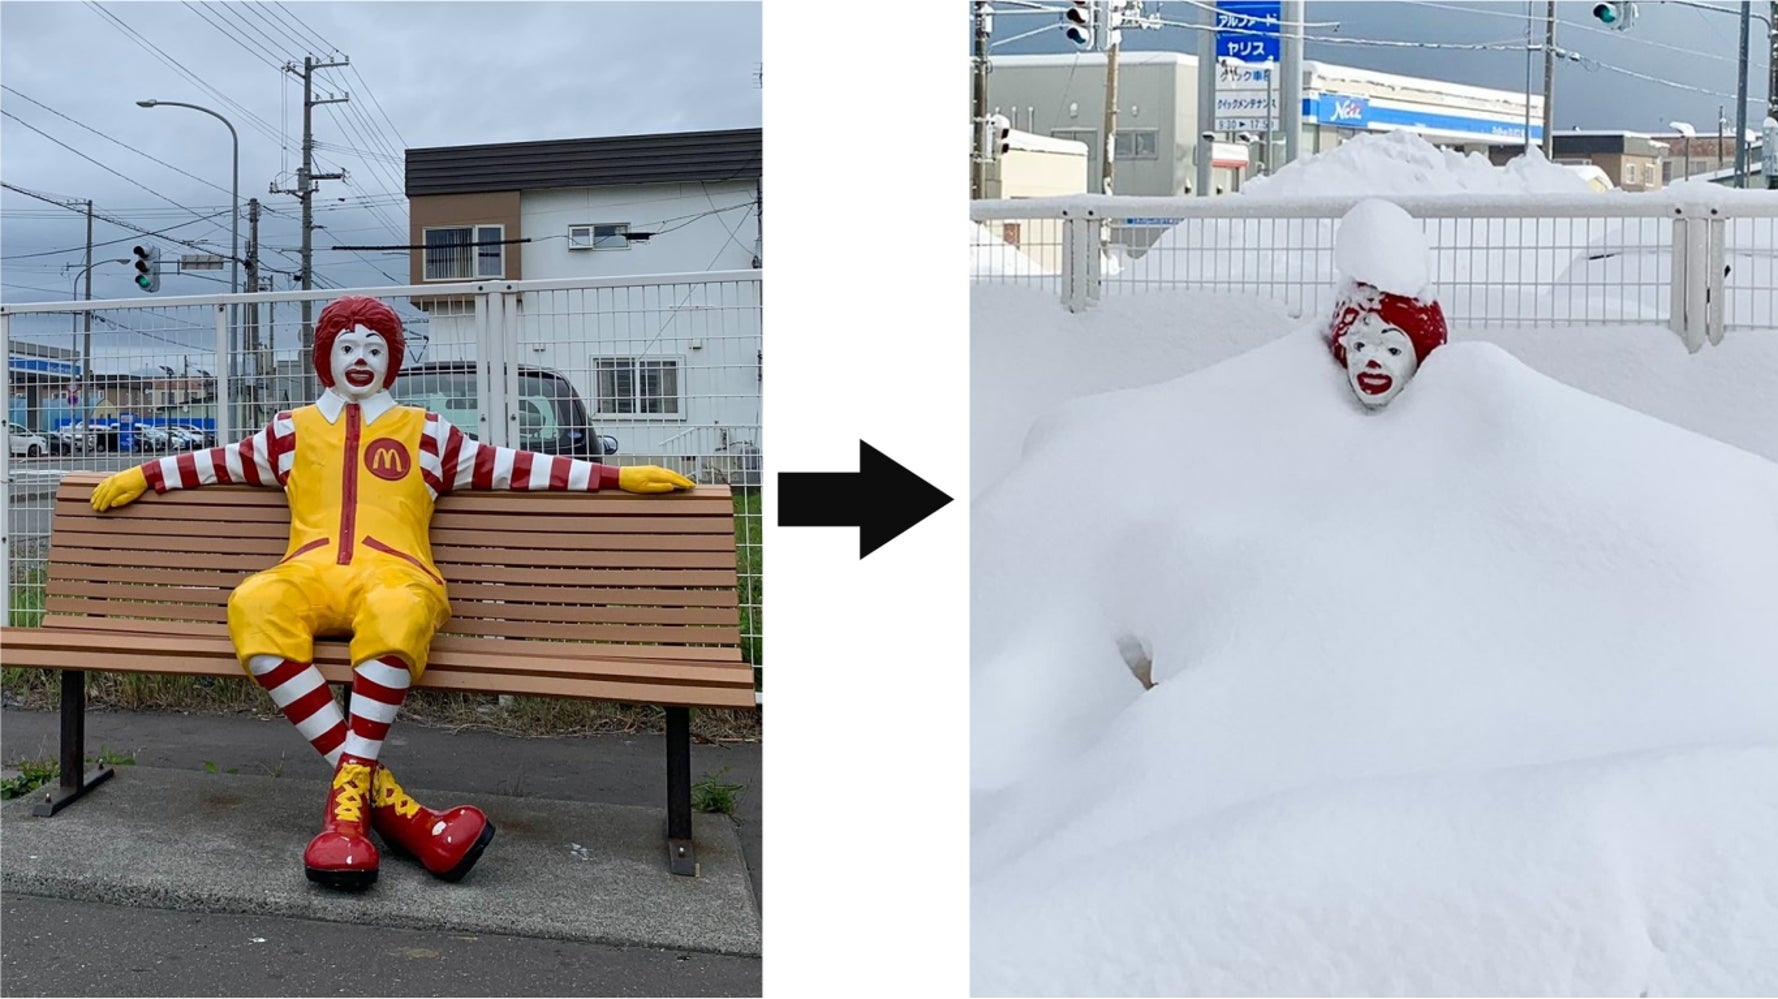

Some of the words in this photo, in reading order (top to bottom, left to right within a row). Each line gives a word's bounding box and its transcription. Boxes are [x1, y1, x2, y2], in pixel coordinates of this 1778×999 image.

[1218, 13, 1278, 28] アルファド
[1227, 41, 1265, 56] ヤリス
[1217, 98, 1277, 109] クイックメンテナンス
